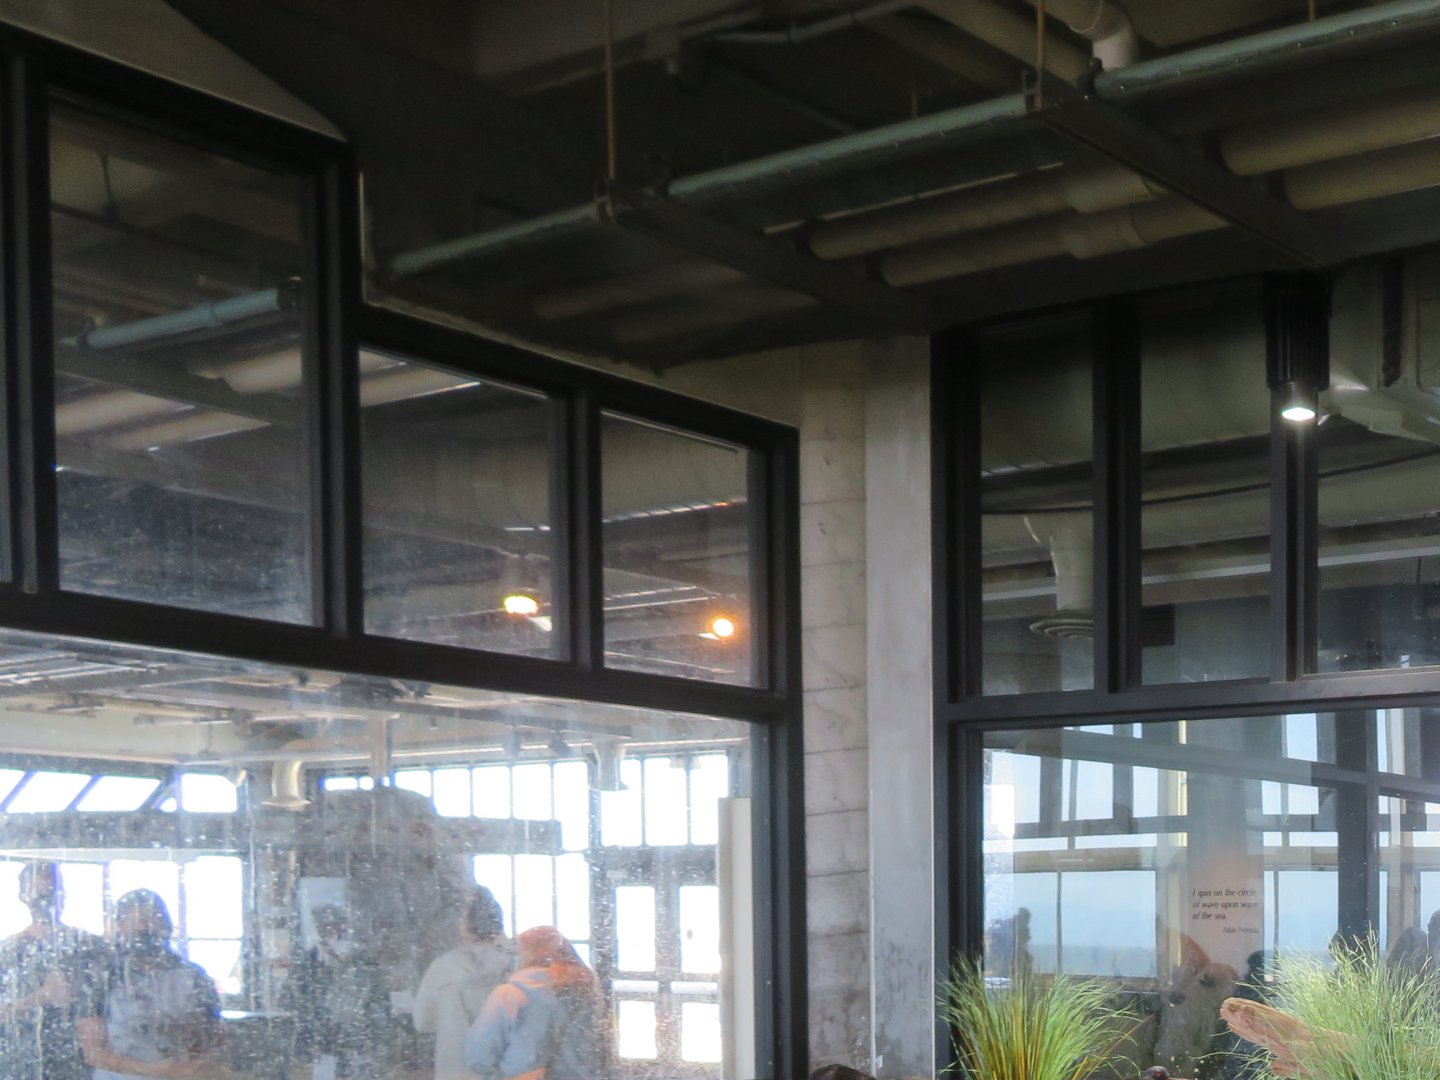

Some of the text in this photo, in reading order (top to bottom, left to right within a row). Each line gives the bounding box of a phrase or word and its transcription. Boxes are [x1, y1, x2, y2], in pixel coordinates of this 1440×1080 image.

[1198, 888, 1211, 898] spin
[1225, 888, 1236, 896] the
[1237, 888, 1257, 896] circle
[1192, 900, 1200, 908] of
[1220, 902, 1239, 910] upon
[1192, 911, 1200, 920] of
[1201, 911, 1213, 920] the
